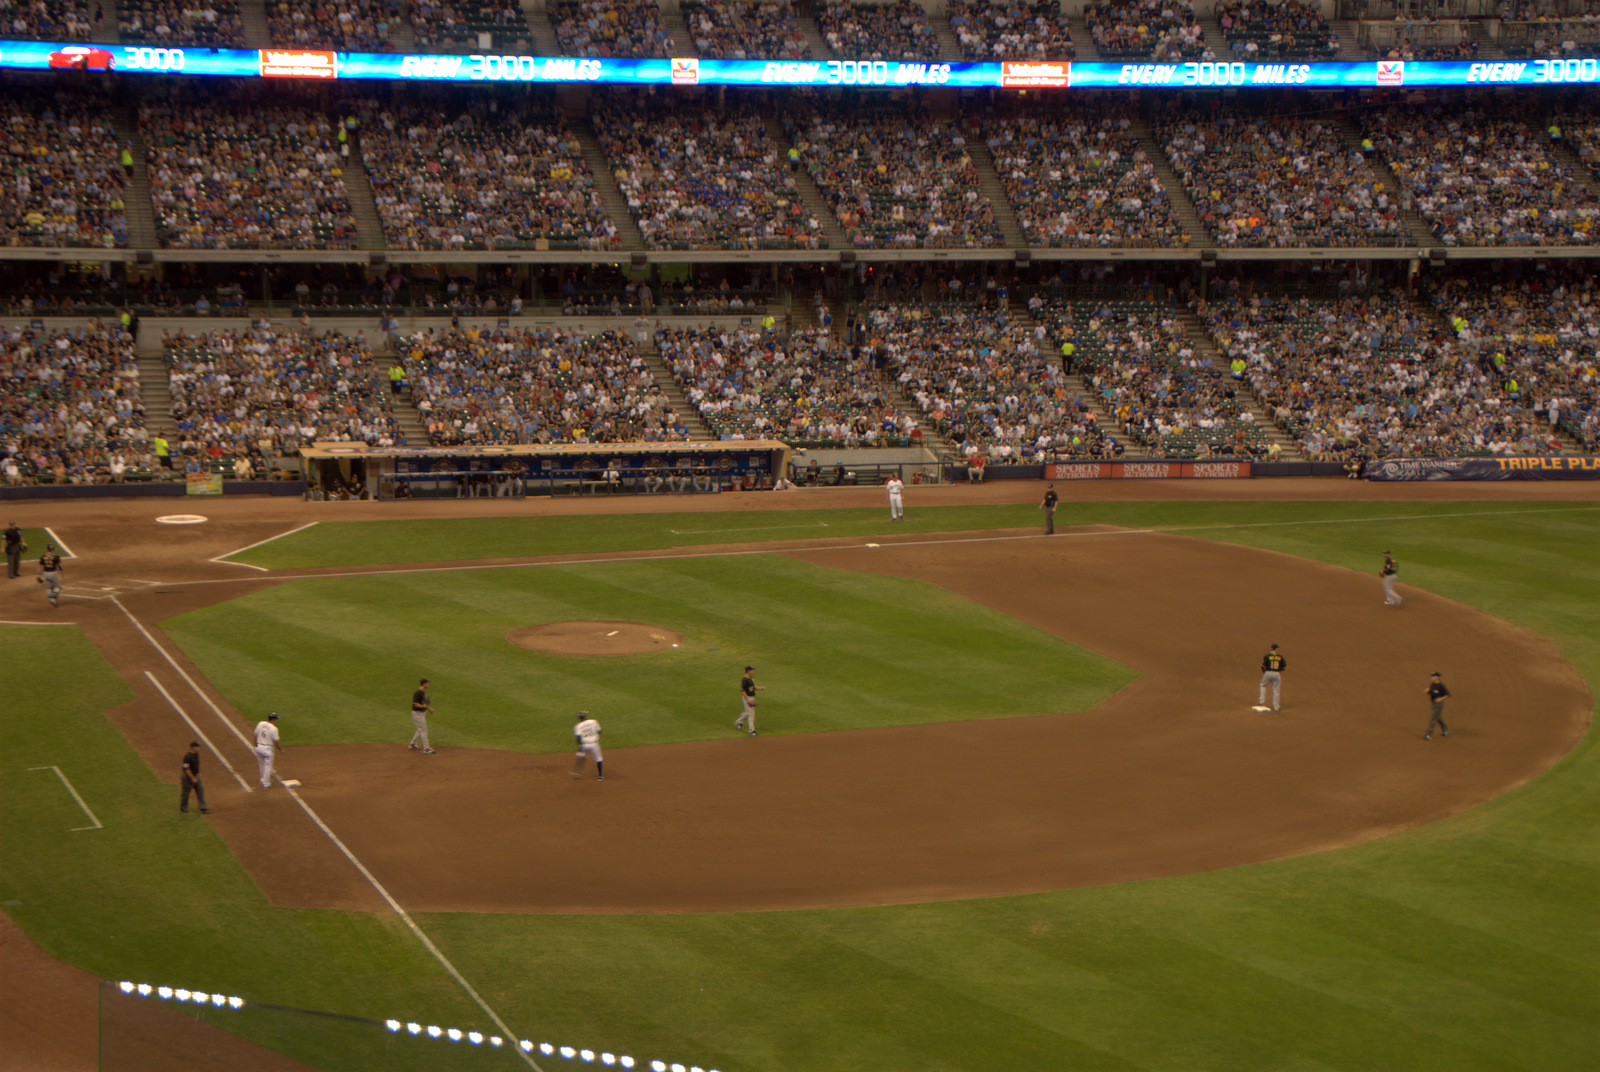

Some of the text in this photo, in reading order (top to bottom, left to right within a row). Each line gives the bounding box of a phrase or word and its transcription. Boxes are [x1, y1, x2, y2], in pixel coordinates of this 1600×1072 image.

[124, 47, 185, 70] 3000
[399, 55, 602, 80] EVERY 3000 MILES
[761, 61, 951, 84] EVERY 3000 MILES
[1117, 62, 1310, 84] EVERY 3000 MILES
[1466, 58, 1597, 82] EVERY 3000
[1055, 463, 1100, 473] SPORTS
[1123, 462, 1169, 472] SPORTS
[1193, 462, 1239, 472] SPORTS
[1495, 457, 1563, 470] TRIPLE
